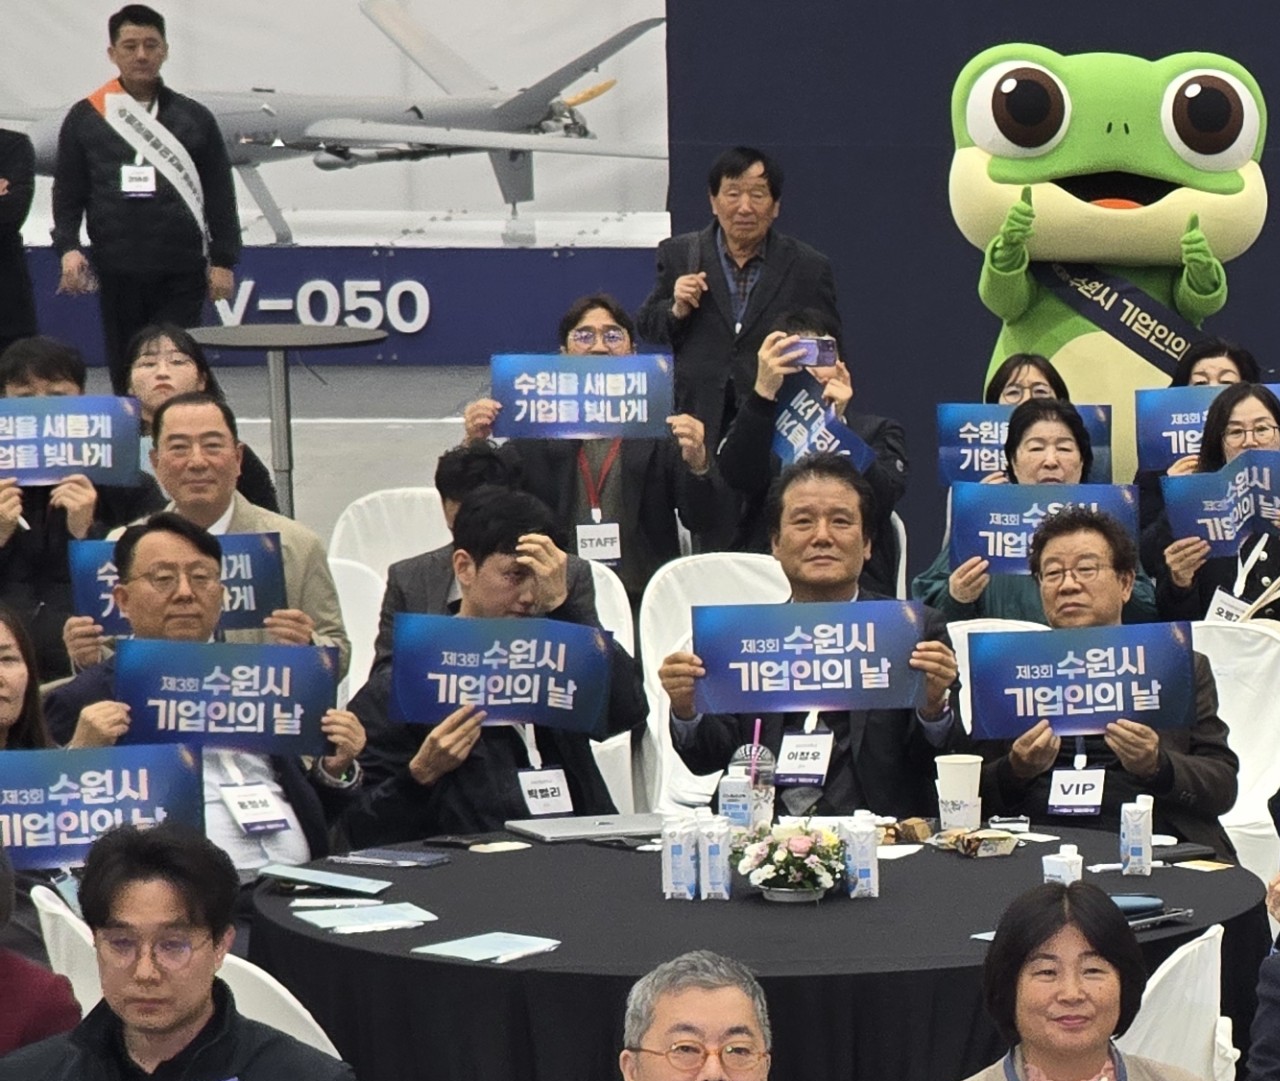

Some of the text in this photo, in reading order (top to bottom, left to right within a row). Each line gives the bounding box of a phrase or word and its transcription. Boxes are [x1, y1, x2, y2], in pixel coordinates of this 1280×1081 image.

[1069, 276, 1191, 361] 수원시 기업인의
[514, 371, 647, 398] 수원을 새롭게
[515, 397, 648, 424] 기업을 빛나게
[0, 415, 111, 440] 원을 새롭게
[1163, 431, 1203, 454] 기업
[0, 444, 112, 470] 업을 빛나게
[580, 537, 618, 548] STAFF
[979, 531, 1032, 557] 기업
[783, 623, 876, 653] 수원시
[440, 638, 566, 672] 제3회 수원시
[1056, 646, 1145, 677] 수원시
[160, 664, 291, 698] 제3회 수원시
[730, 658, 890, 691] 기업인의 날
[427, 672, 577, 710] 기업인의 날
[1004, 680, 1160, 716] 기업인의 날
[148, 699, 303, 735] 기업인의 날
[2, 769, 149, 805] 제3회 수원시
[1060, 783, 1096, 796] VIP
